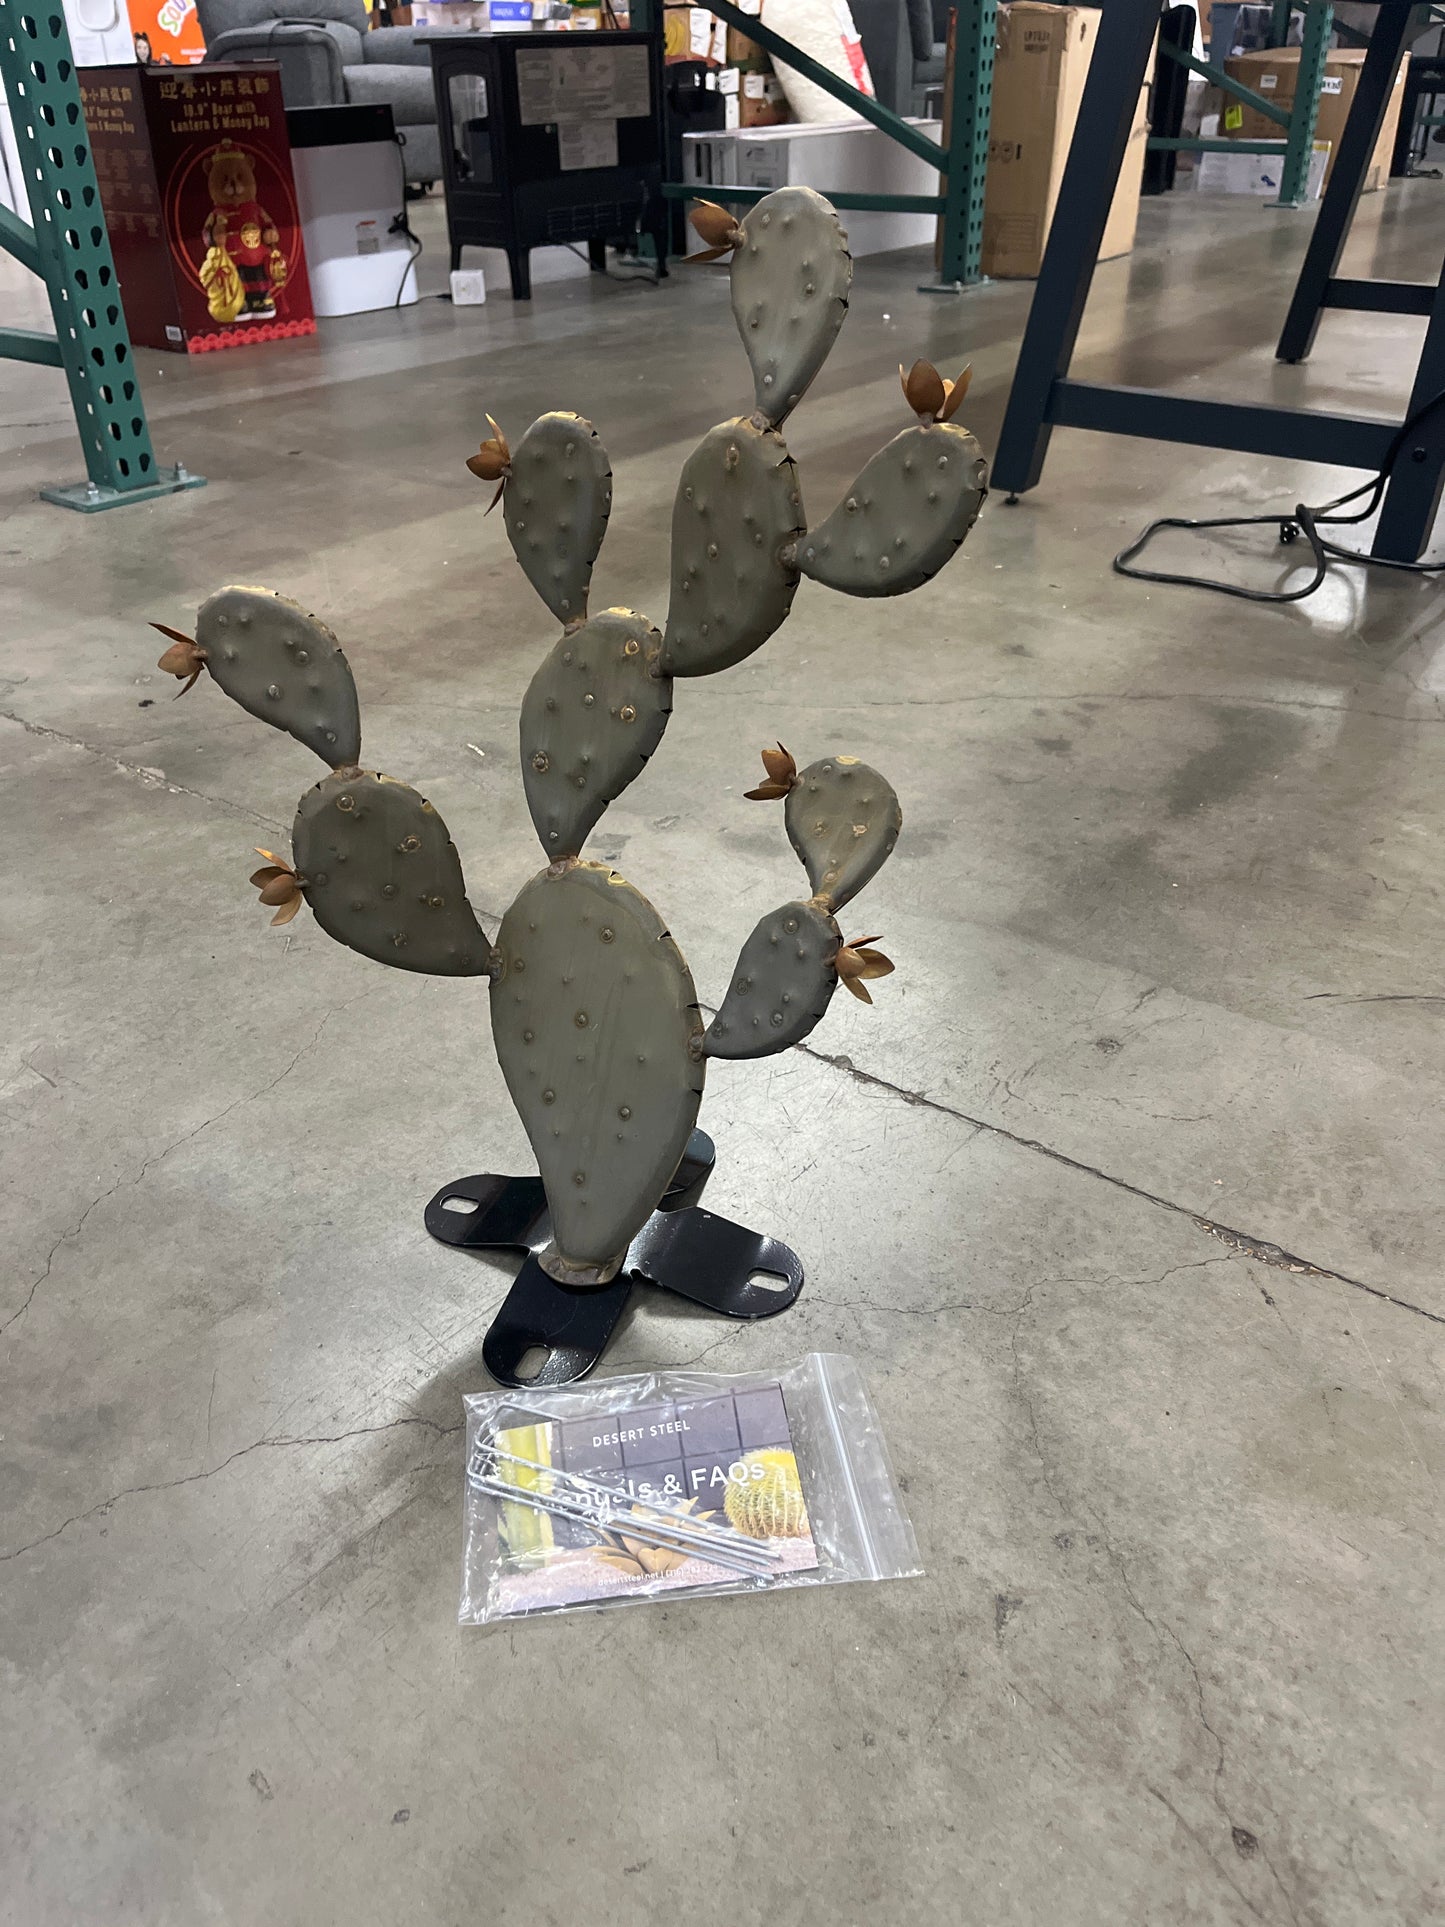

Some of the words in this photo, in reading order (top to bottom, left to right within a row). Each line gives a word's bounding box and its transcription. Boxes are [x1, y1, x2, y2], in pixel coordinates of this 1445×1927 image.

[170, 119, 210, 133] Lantern
[222, 115, 252, 130] Money
[592, 1427, 644, 1448] DESERT
[650, 1419, 691, 1438] STEEL
[663, 1473, 683, 1495] &
[691, 1461, 766, 1491] FAQs
